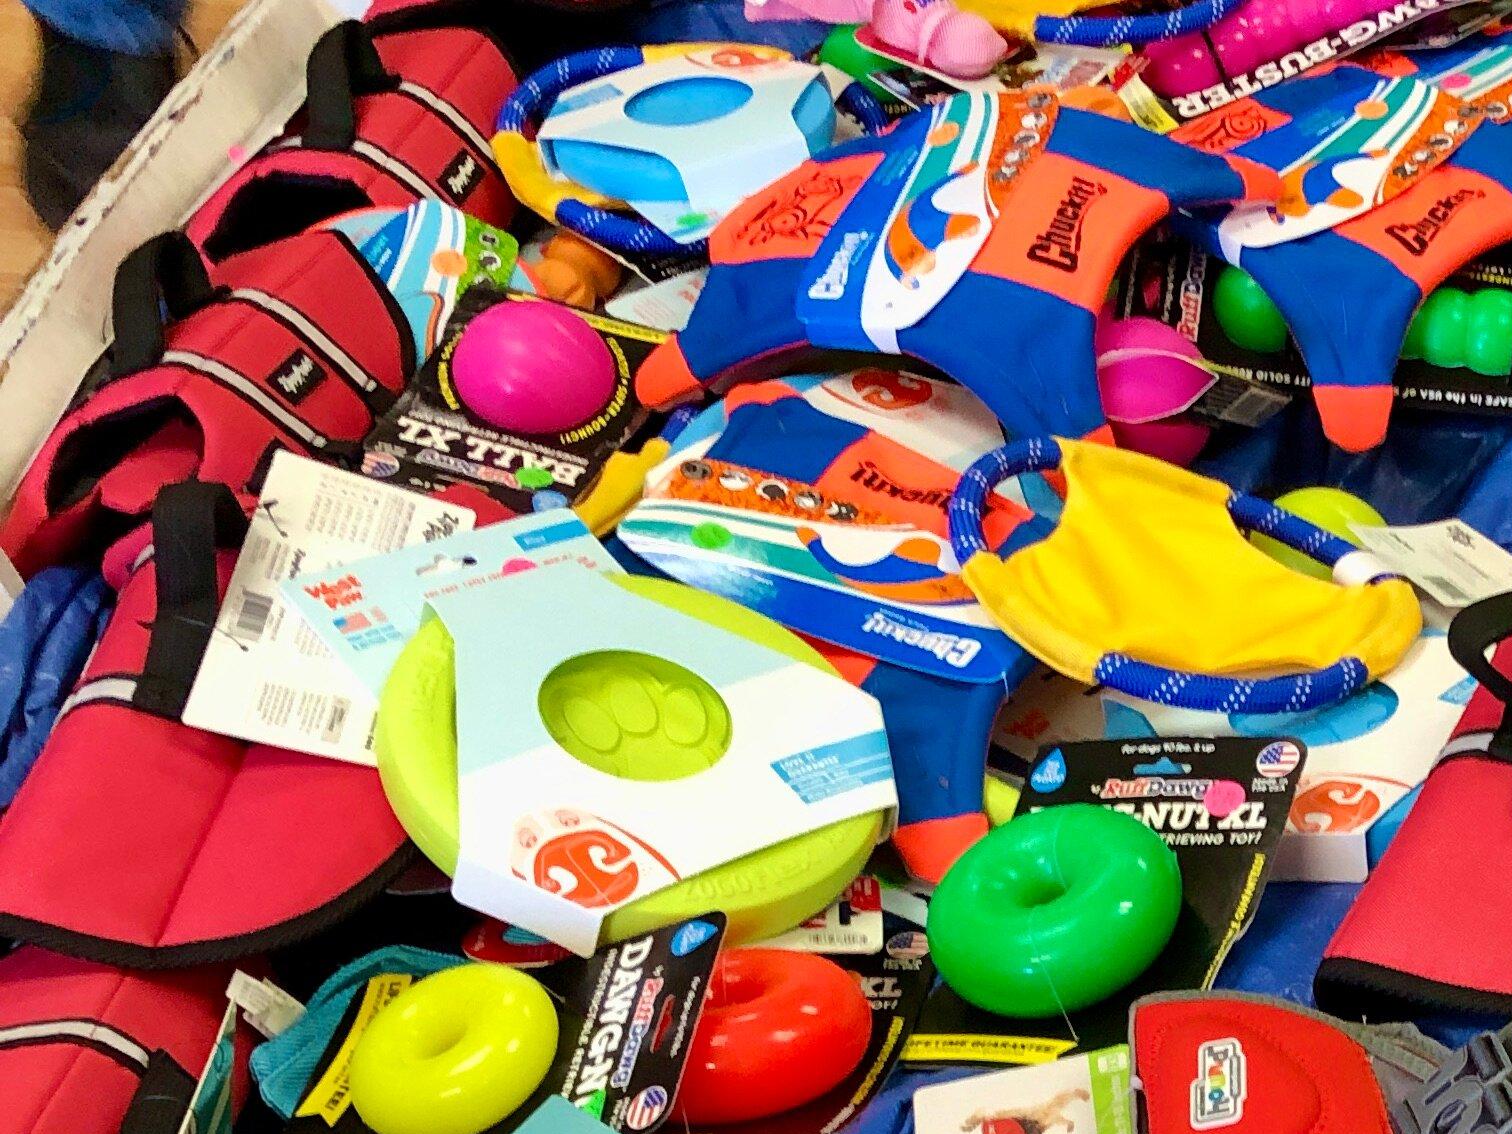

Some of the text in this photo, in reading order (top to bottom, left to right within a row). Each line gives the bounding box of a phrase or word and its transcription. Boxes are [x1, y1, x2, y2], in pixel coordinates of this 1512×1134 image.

[1419, 387, 1442, 401] USA
[398, 415, 464, 454] XL
[460, 434, 586, 488] BALL
[1218, 802, 1267, 830] XL
[572, 935, 654, 1106] DAWG-N
[869, 999, 897, 1009] OY!
